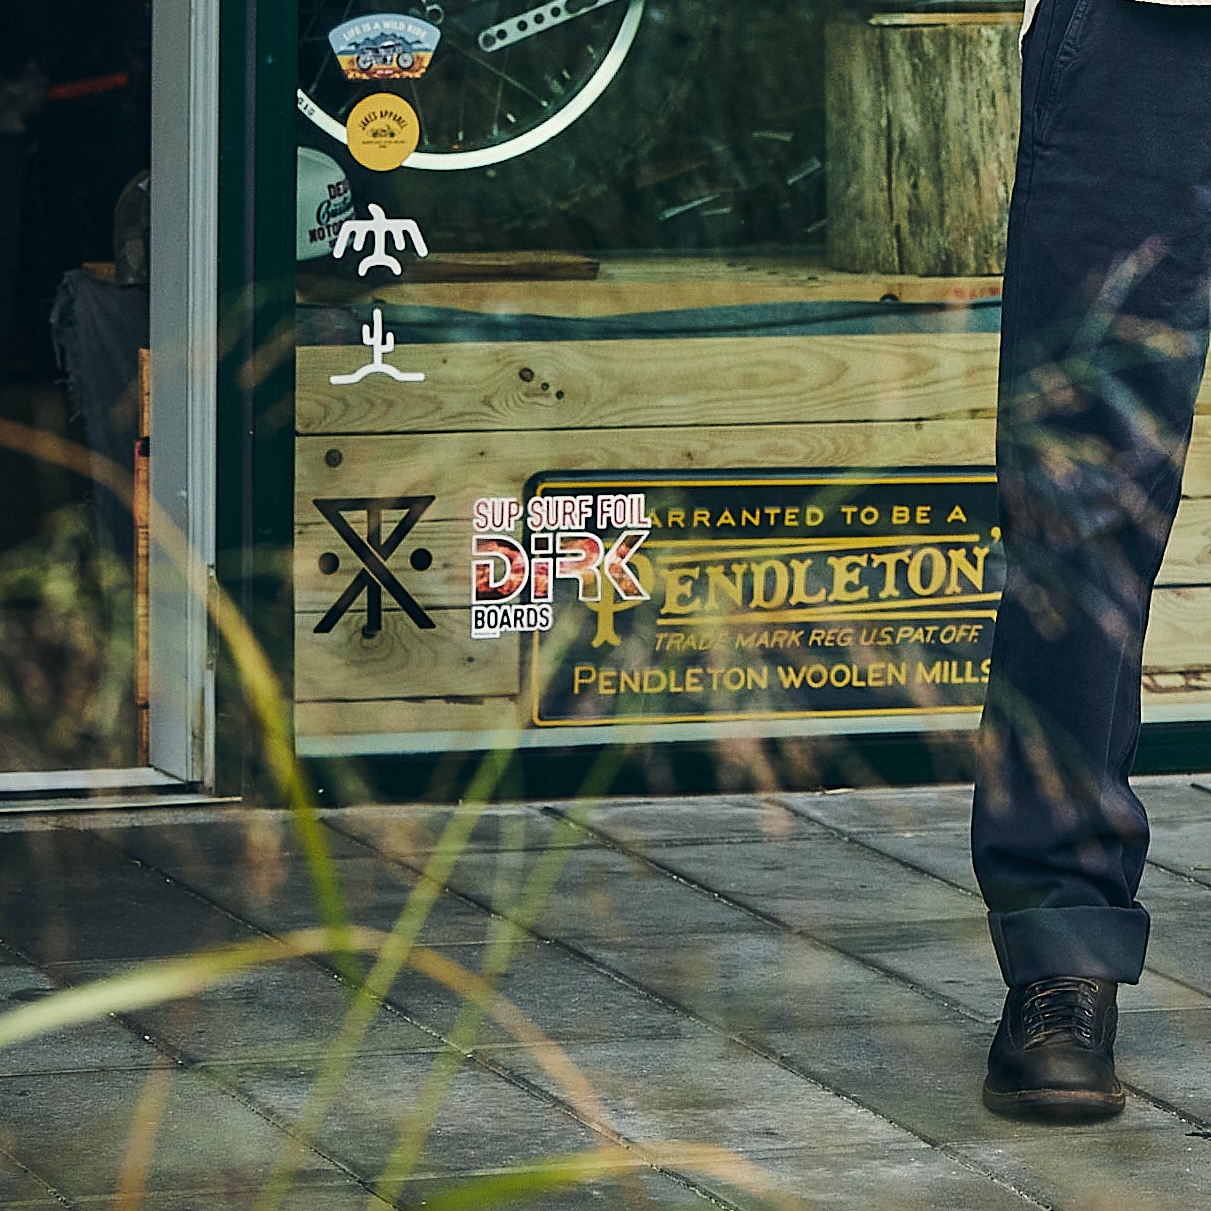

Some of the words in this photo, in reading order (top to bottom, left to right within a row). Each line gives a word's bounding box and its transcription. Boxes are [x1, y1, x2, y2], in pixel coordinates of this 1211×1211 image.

[342, 25, 363, 41] LIFE
[363, 22, 372, 33] IS
[372, 21, 381, 31] A
[381, 20, 406, 32] WILD
[406, 22, 428, 39] RIDE
[474, 498, 522, 530] SUP
[528, 495, 593, 530] SURF
[597, 494, 652, 529] FOIL
[644, 505, 824, 529] ARRANTED
[841, 505, 879, 525] TO
[891, 504, 932, 525] BE
[946, 504, 968, 523] A
[473, 605, 552, 631] BOARDS
[654, 631, 729, 652] TRADE
[735, 629, 806, 649] MARK
[573, 664, 769, 696] PENDLETON
[778, 662, 908, 690] WOOLEN
[914, 658, 991, 687] MILLS
